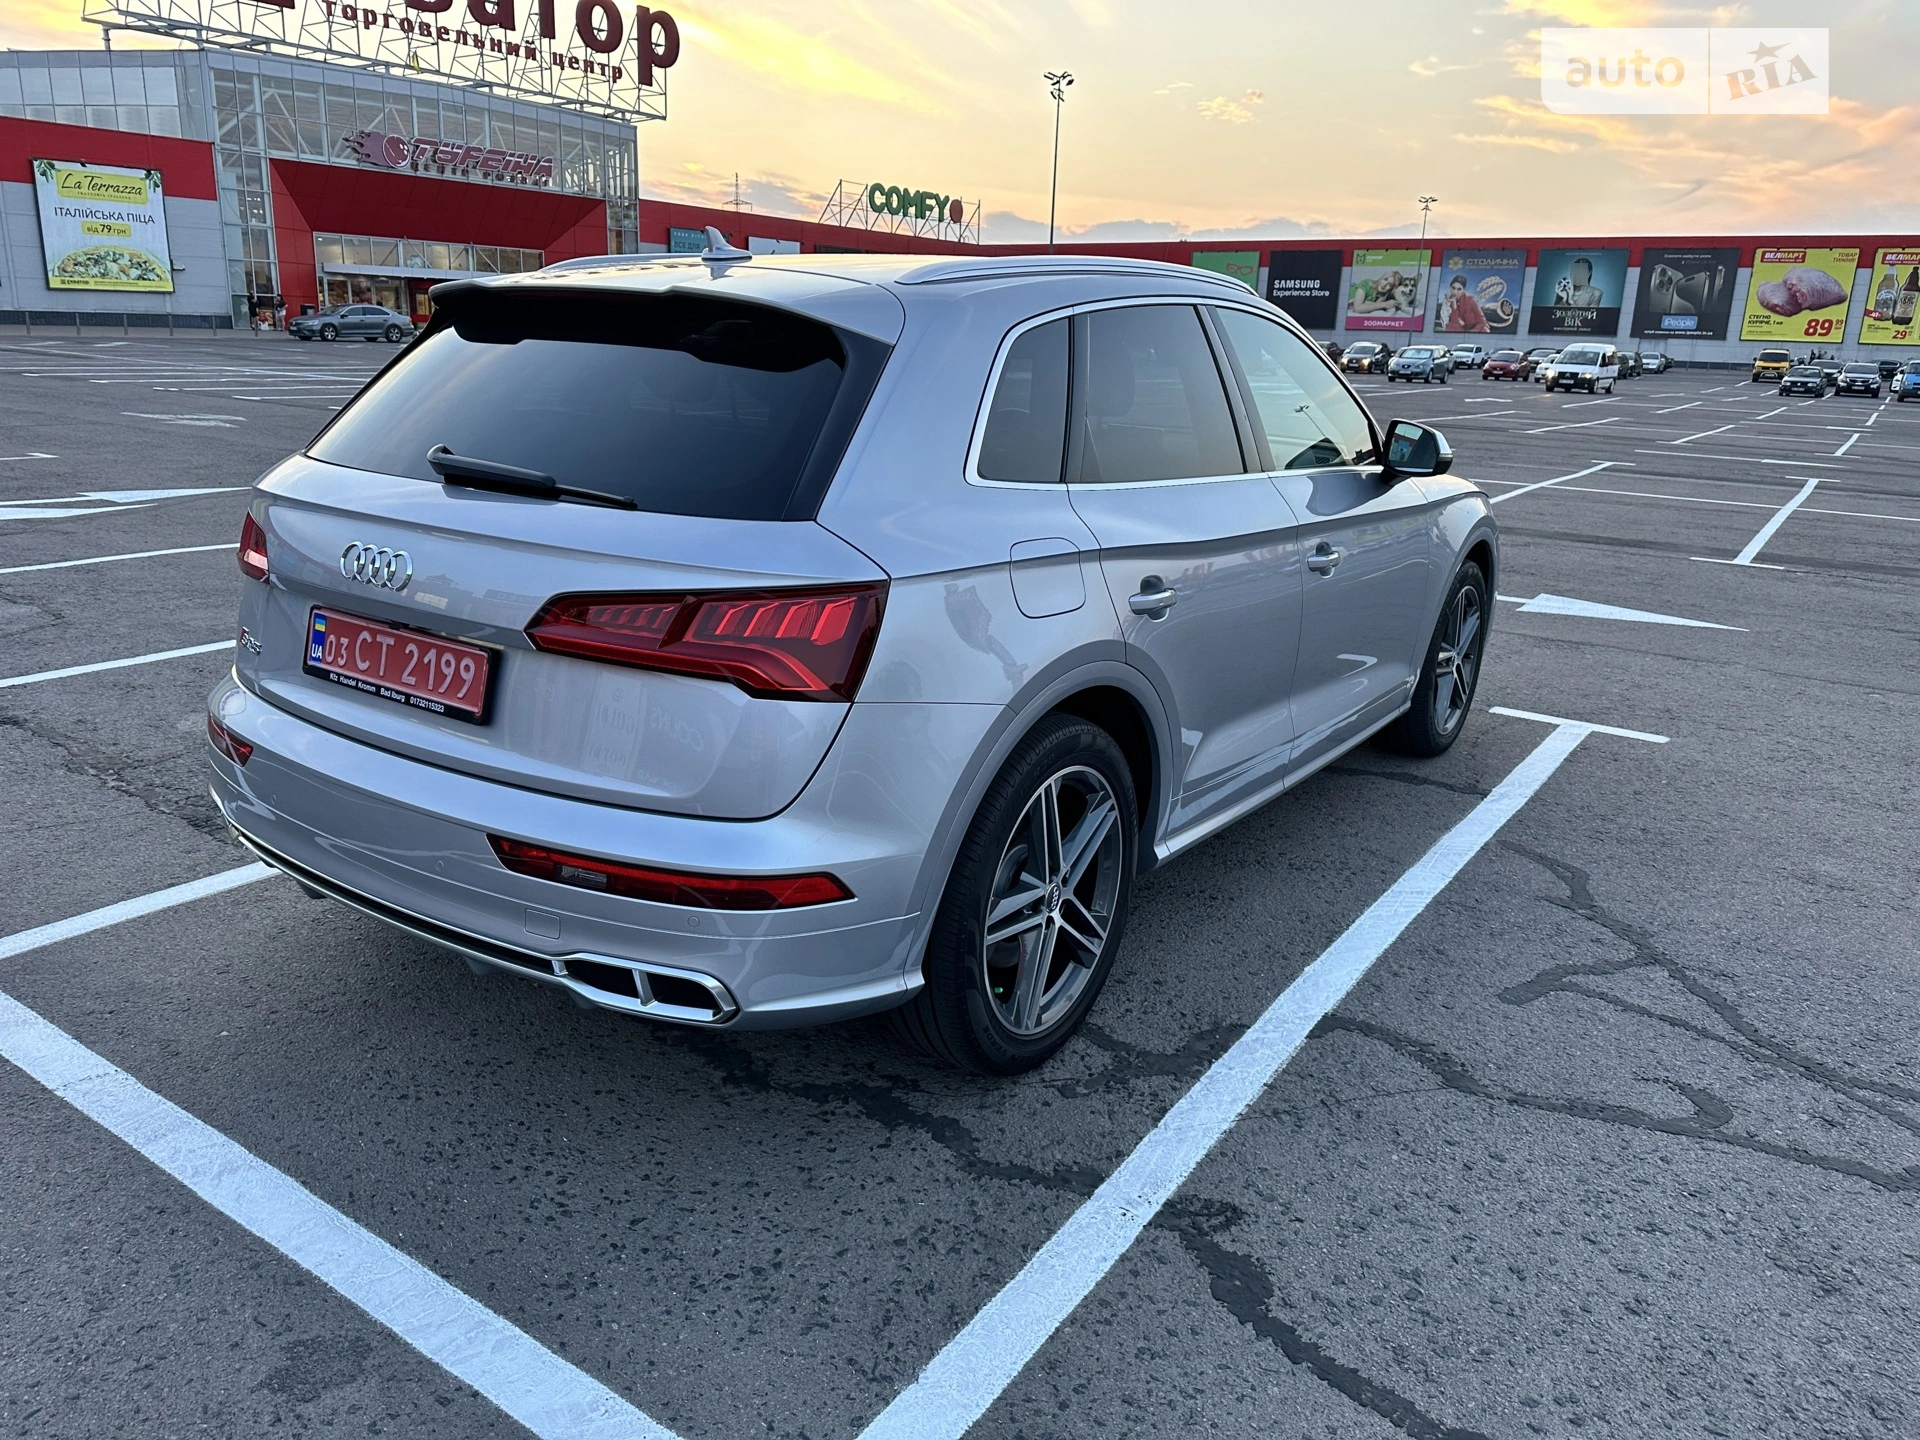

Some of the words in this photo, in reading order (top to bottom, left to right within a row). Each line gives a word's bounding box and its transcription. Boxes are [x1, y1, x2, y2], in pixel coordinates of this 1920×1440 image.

[320, 0, 538, 61] торговельний
[553, 50, 623, 83] центр
[61, 173, 82, 190] La
[84, 175, 143, 196] Terrazza
[869, 183, 950, 222] COMFY
[54, 206, 125, 222] ІТАЛІЙСЬКА
[127, 212, 155, 226] ПІЦА
[87, 225, 99, 234] від
[99, 224, 112, 233] 79
[1273, 289, 1311, 298] Experience
[1274, 280, 1321, 288] SAMSUNG
[1804, 318, 1834, 336] 89
[1892, 330, 1907, 340] 29
[311, 643, 322, 659] UA
[325, 634, 349, 667] 03
[401, 642, 475, 699] 2199
[329, 672, 338, 682] Kfz
[340, 675, 356, 687] Handel
[357, 681, 376, 692] Kromm
[380, 687, 391, 697] Bad
[409, 696, 445, 712] 01732115323
